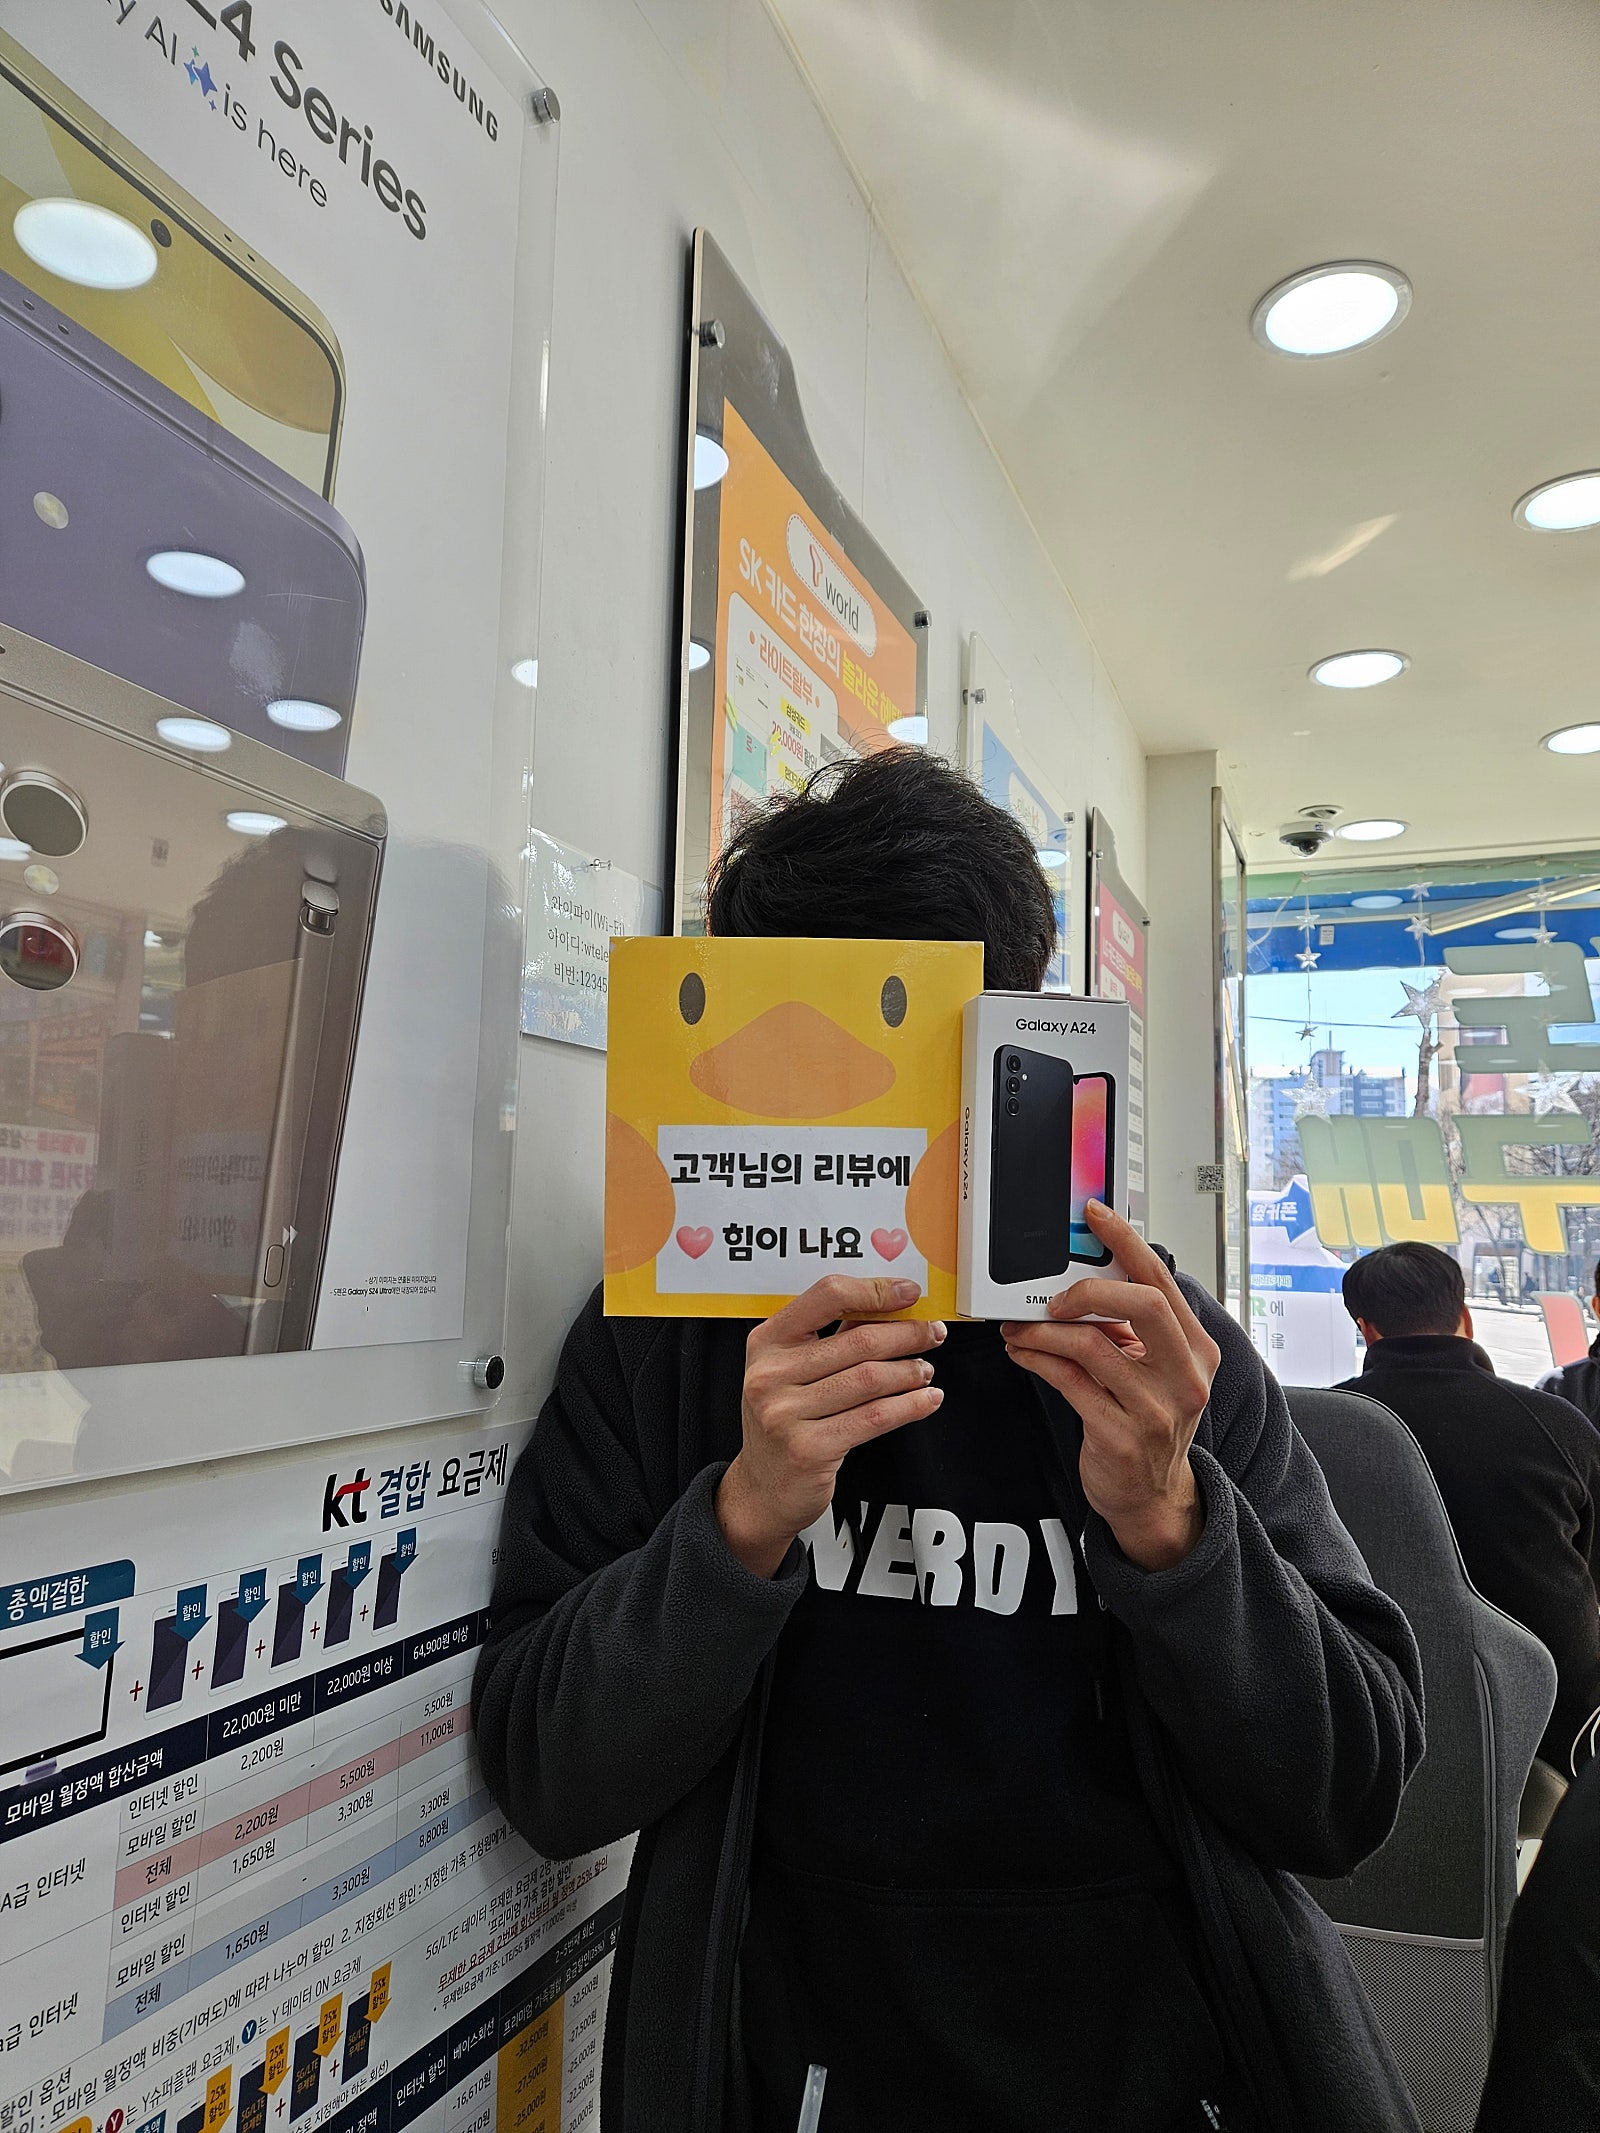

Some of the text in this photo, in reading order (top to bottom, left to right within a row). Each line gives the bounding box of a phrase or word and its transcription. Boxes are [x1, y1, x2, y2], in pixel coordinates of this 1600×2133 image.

[223, 82, 248, 131] is
[258, 118, 327, 208] here
[270, 40, 427, 240] Series
[825, 577, 860, 633] world
[738, 537, 763, 595] SK
[765, 564, 797, 633] 카드
[799, 602, 841, 679] 한장의
[843, 650, 879, 719] 놀라운
[759, 634, 813, 706] 라이트할부
[1015, 1018, 1097, 1036] Galaxy A24
[670, 1151, 911, 1189] 고객님의 리뷰에
[722, 1223, 864, 1262] 힘이 나요
[347, 1287, 368, 1298] Galaxy
[368, 1287, 379, 1296] S24
[322, 1443, 509, 1532] kt 결합 요금제
[352, 1555, 367, 1573] 할인
[400, 1542, 414, 1558] 할인
[243, 1585, 261, 1604] 할인
[301, 1569, 317, 1587] 할인
[7, 1574, 90, 1622] 총액결합
[182, 1601, 202, 1622] 할인
[89, 1627, 112, 1650] 할인
[412, 1632, 451, 1661] 64,900원
[452, 1624, 469, 1643] 이상
[326, 1655, 394, 1697] 22,000원 이상
[222, 1690, 302, 1739] 22,000원 미만
[423, 1690, 454, 1718] 5,500원
[420, 1717, 454, 1748] 11,000원
[240, 1737, 285, 1771] 2,200원
[4, 1748, 164, 1826] 모바일 월정액 합산금액
[339, 1758, 376, 1790] 5,500원
[129, 1773, 199, 1820] 인터넷 할인
[337, 1788, 374, 1822] 3,300원
[420, 1787, 450, 1820] 3,300원
[125, 1809, 197, 1857] 모바일 할인
[234, 1804, 279, 1841] 2,200원
[419, 1817, 449, 1849] 8,800원
[145, 1855, 173, 1886] 전체
[232, 1838, 276, 1874] 1,650원
[37, 1857, 86, 1898] 인터넷
[331, 1865, 371, 1901] 3,300원
[121, 1881, 191, 1934] 인터넷 할인
[425, 1926, 460, 1961] 5G/LTE
[461, 1905, 487, 1934] 데이터
[488, 1886, 513, 1916] 무제한
[514, 1870, 538, 1897] 요금제
[523, 1892, 538, 1910] 가족
[224, 1920, 270, 1960] 1,650원
[115, 1933, 186, 1989] 모바일 할인
[438, 1962, 467, 1994] 무제한
[51, 2078, 98, 2125] 모바일
[103, 2046, 147, 2093] 월정액
[151, 1988, 241, 2057] 비중(기여도)에
[245, 1972, 270, 1999] 따라
[273, 1951, 308, 1982] 나누어
[312, 1933, 335, 1963] 할인
[354, 1898, 395, 1935] 지정회선
[398, 1886, 416, 1911] 할인
[423, 1863, 449, 1892] 지정한
[450, 1850, 467, 1874] 가족
[134, 1982, 162, 2015] 전체
[374, 1976, 387, 1995] 25%
[29, 1992, 79, 2038] 인터넷
[323, 2007, 338, 2027] 25%
[142, 2060, 197, 2113] Y슈퍼플랜
[281, 1988, 312, 2018] 데이터
[315, 1976, 330, 1998] ON
[331, 1956, 362, 1987] 요금제
[268, 2042, 285, 2062] 25%
[321, 2023, 338, 2046] 할인
[453, 2017, 495, 2061] 베이스회선
[267, 2060, 285, 2082] 할인
[396, 2055, 447, 2108] 인터넷 할인
[0, 2090, 33, 2130] 할인
[39, 2067, 72, 2106] 옵션
[209, 2082, 227, 2104] 25%
[452, 2070, 492, 2111] -16,610원
[207, 2103, 227, 2124] 할인
